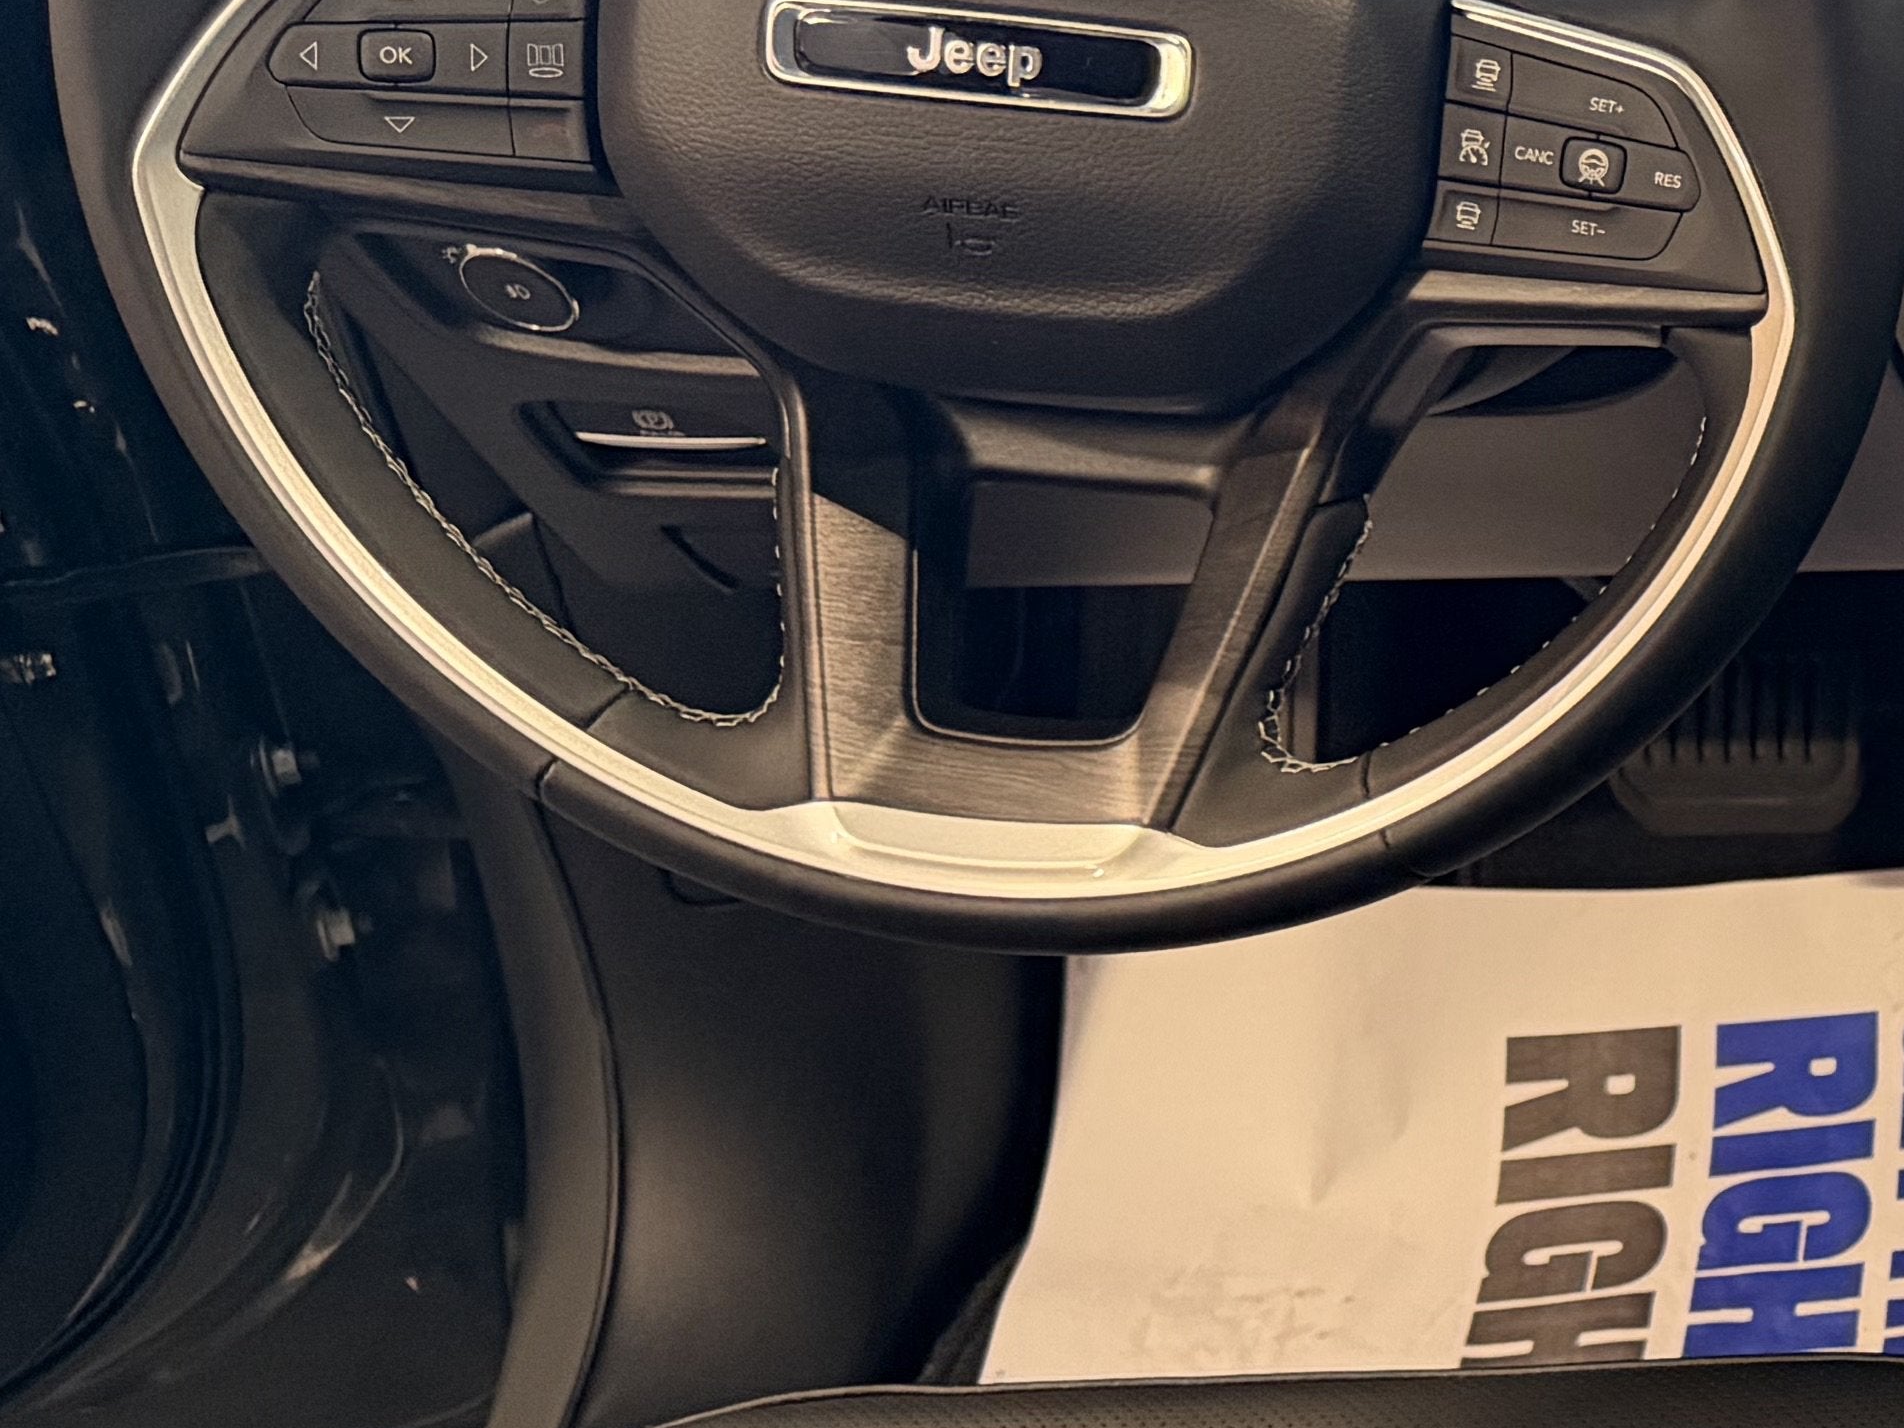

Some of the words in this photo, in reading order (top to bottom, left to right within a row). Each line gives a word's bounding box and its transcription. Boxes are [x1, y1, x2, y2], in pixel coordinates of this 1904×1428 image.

[378, 45, 414, 67] OK
[906, 25, 1044, 86] Jeep
[1588, 97, 1625, 115] SET+
[1514, 144, 1555, 167] CANC
[1653, 172, 1683, 190] RES
[1570, 219, 1606, 237] SET-
